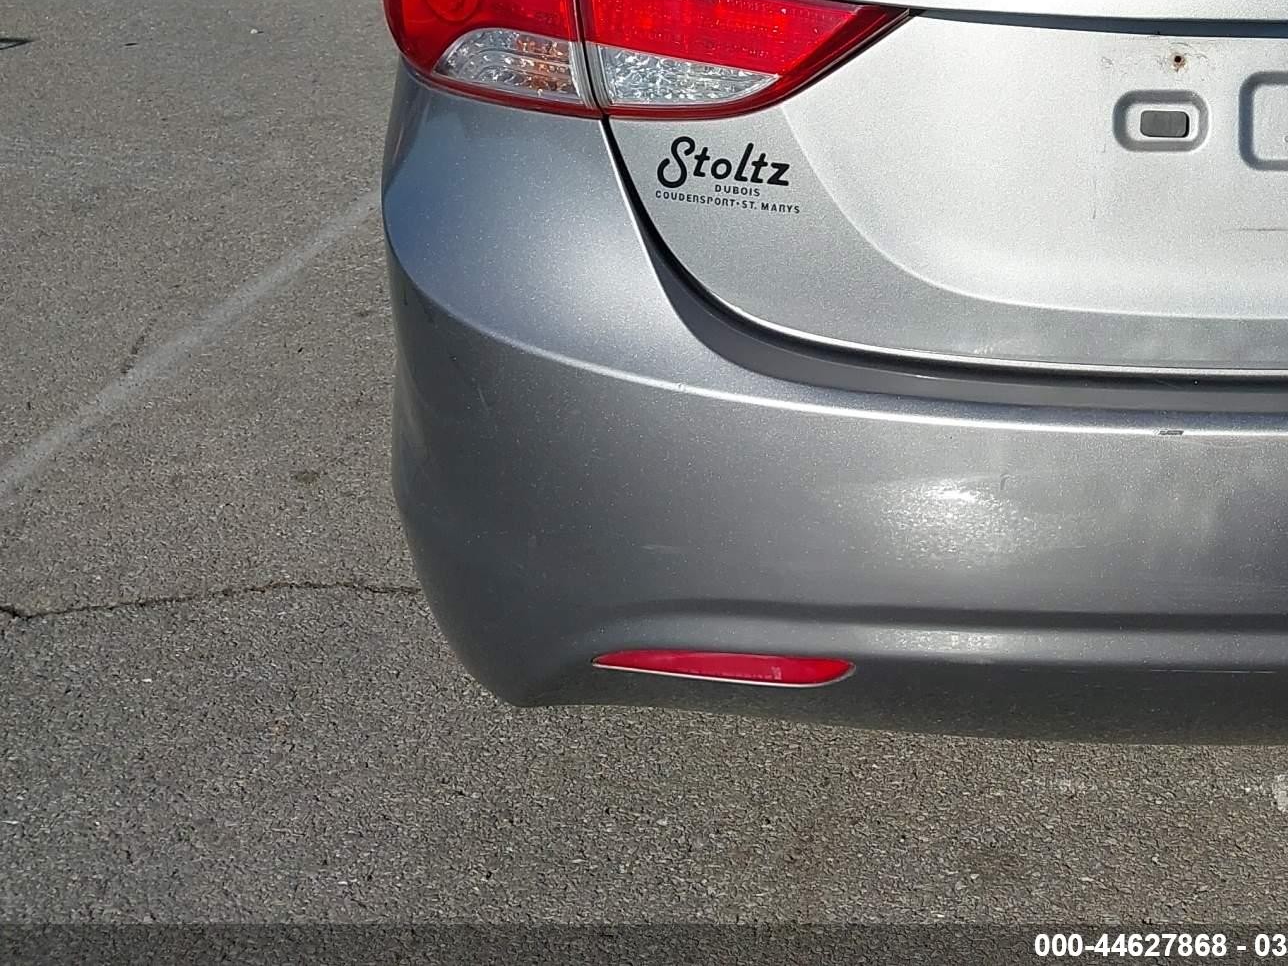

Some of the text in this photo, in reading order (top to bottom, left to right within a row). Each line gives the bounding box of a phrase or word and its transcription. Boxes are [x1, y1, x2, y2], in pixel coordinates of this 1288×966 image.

[657, 136, 790, 189] Stoltz
[715, 184, 760, 197] DUBOIS
[761, 202, 800, 214] MARYS
